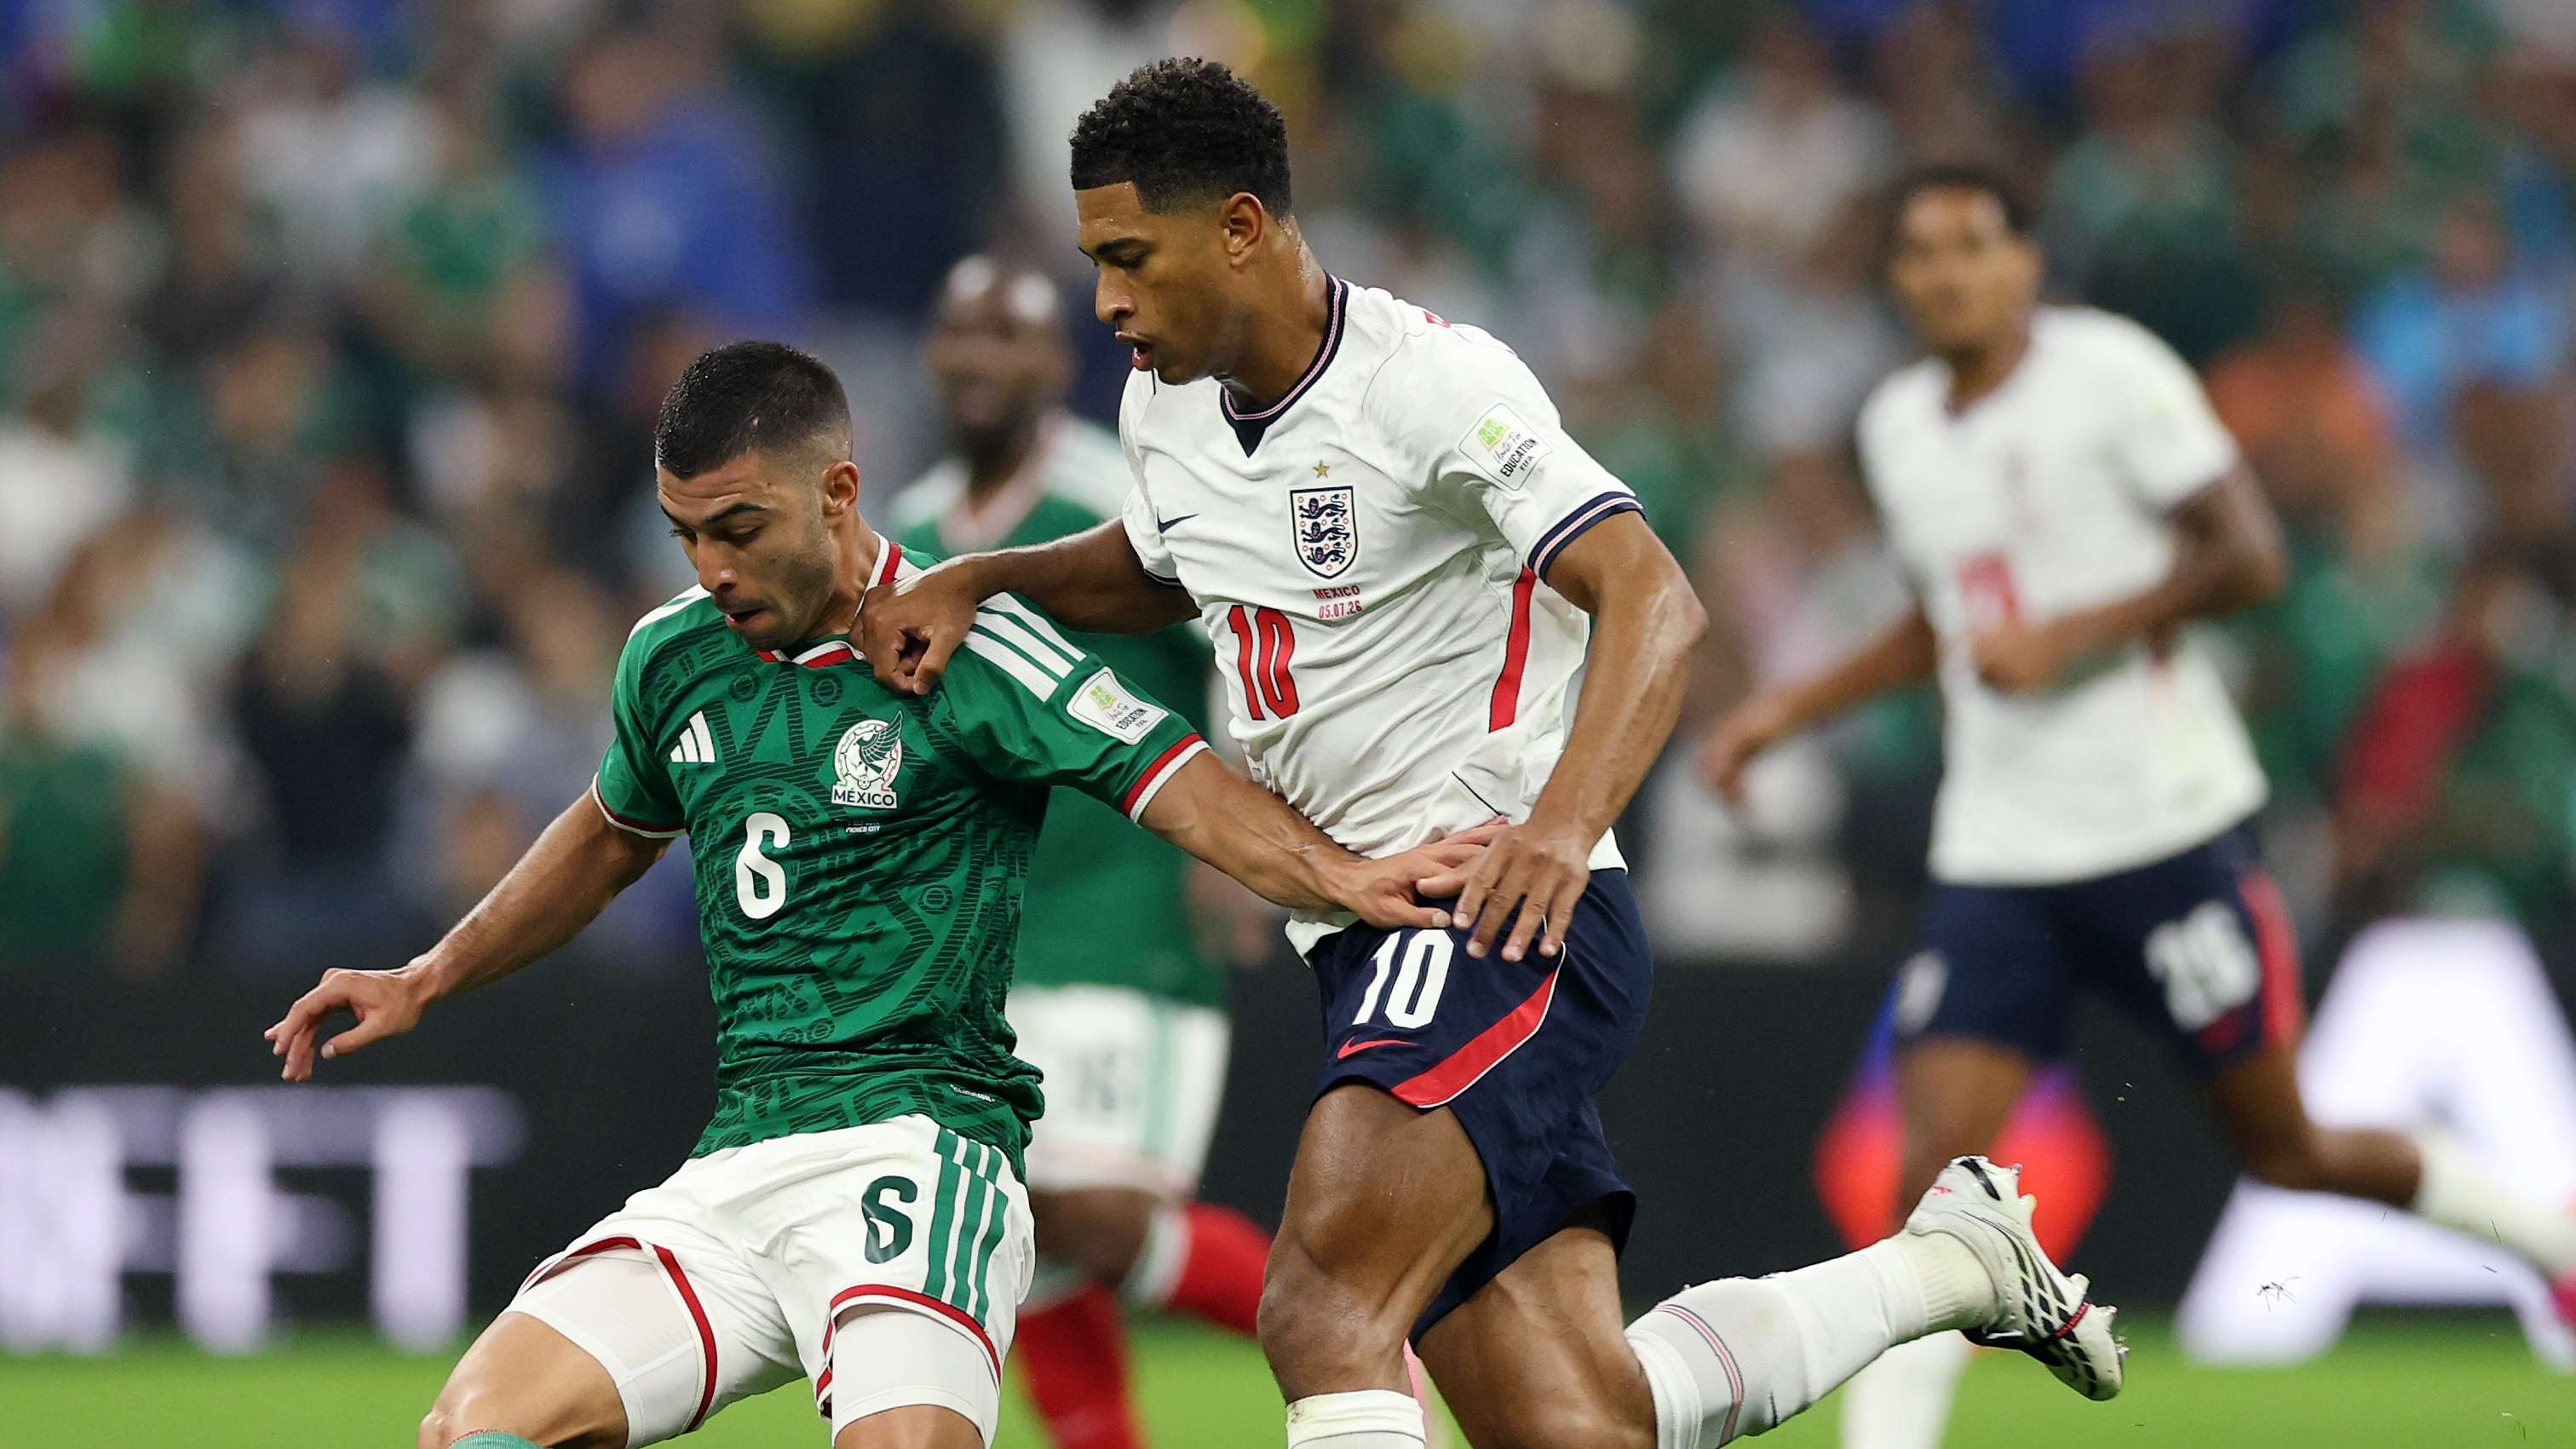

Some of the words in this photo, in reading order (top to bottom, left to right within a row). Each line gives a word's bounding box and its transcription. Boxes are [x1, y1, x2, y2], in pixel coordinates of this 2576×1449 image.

[1499, 438, 1537, 478] EDUCATION
[1519, 456, 1534, 471] FIFA
[1313, 584, 1360, 599] MEXICO
[1319, 600, 1363, 619] 05.07.26
[1227, 604, 1300, 722] 10
[833, 788, 894, 807] MÉXICO
[735, 812, 791, 920] 6
[1352, 929, 1455, 1030] 10
[861, 1175, 918, 1264] 6
